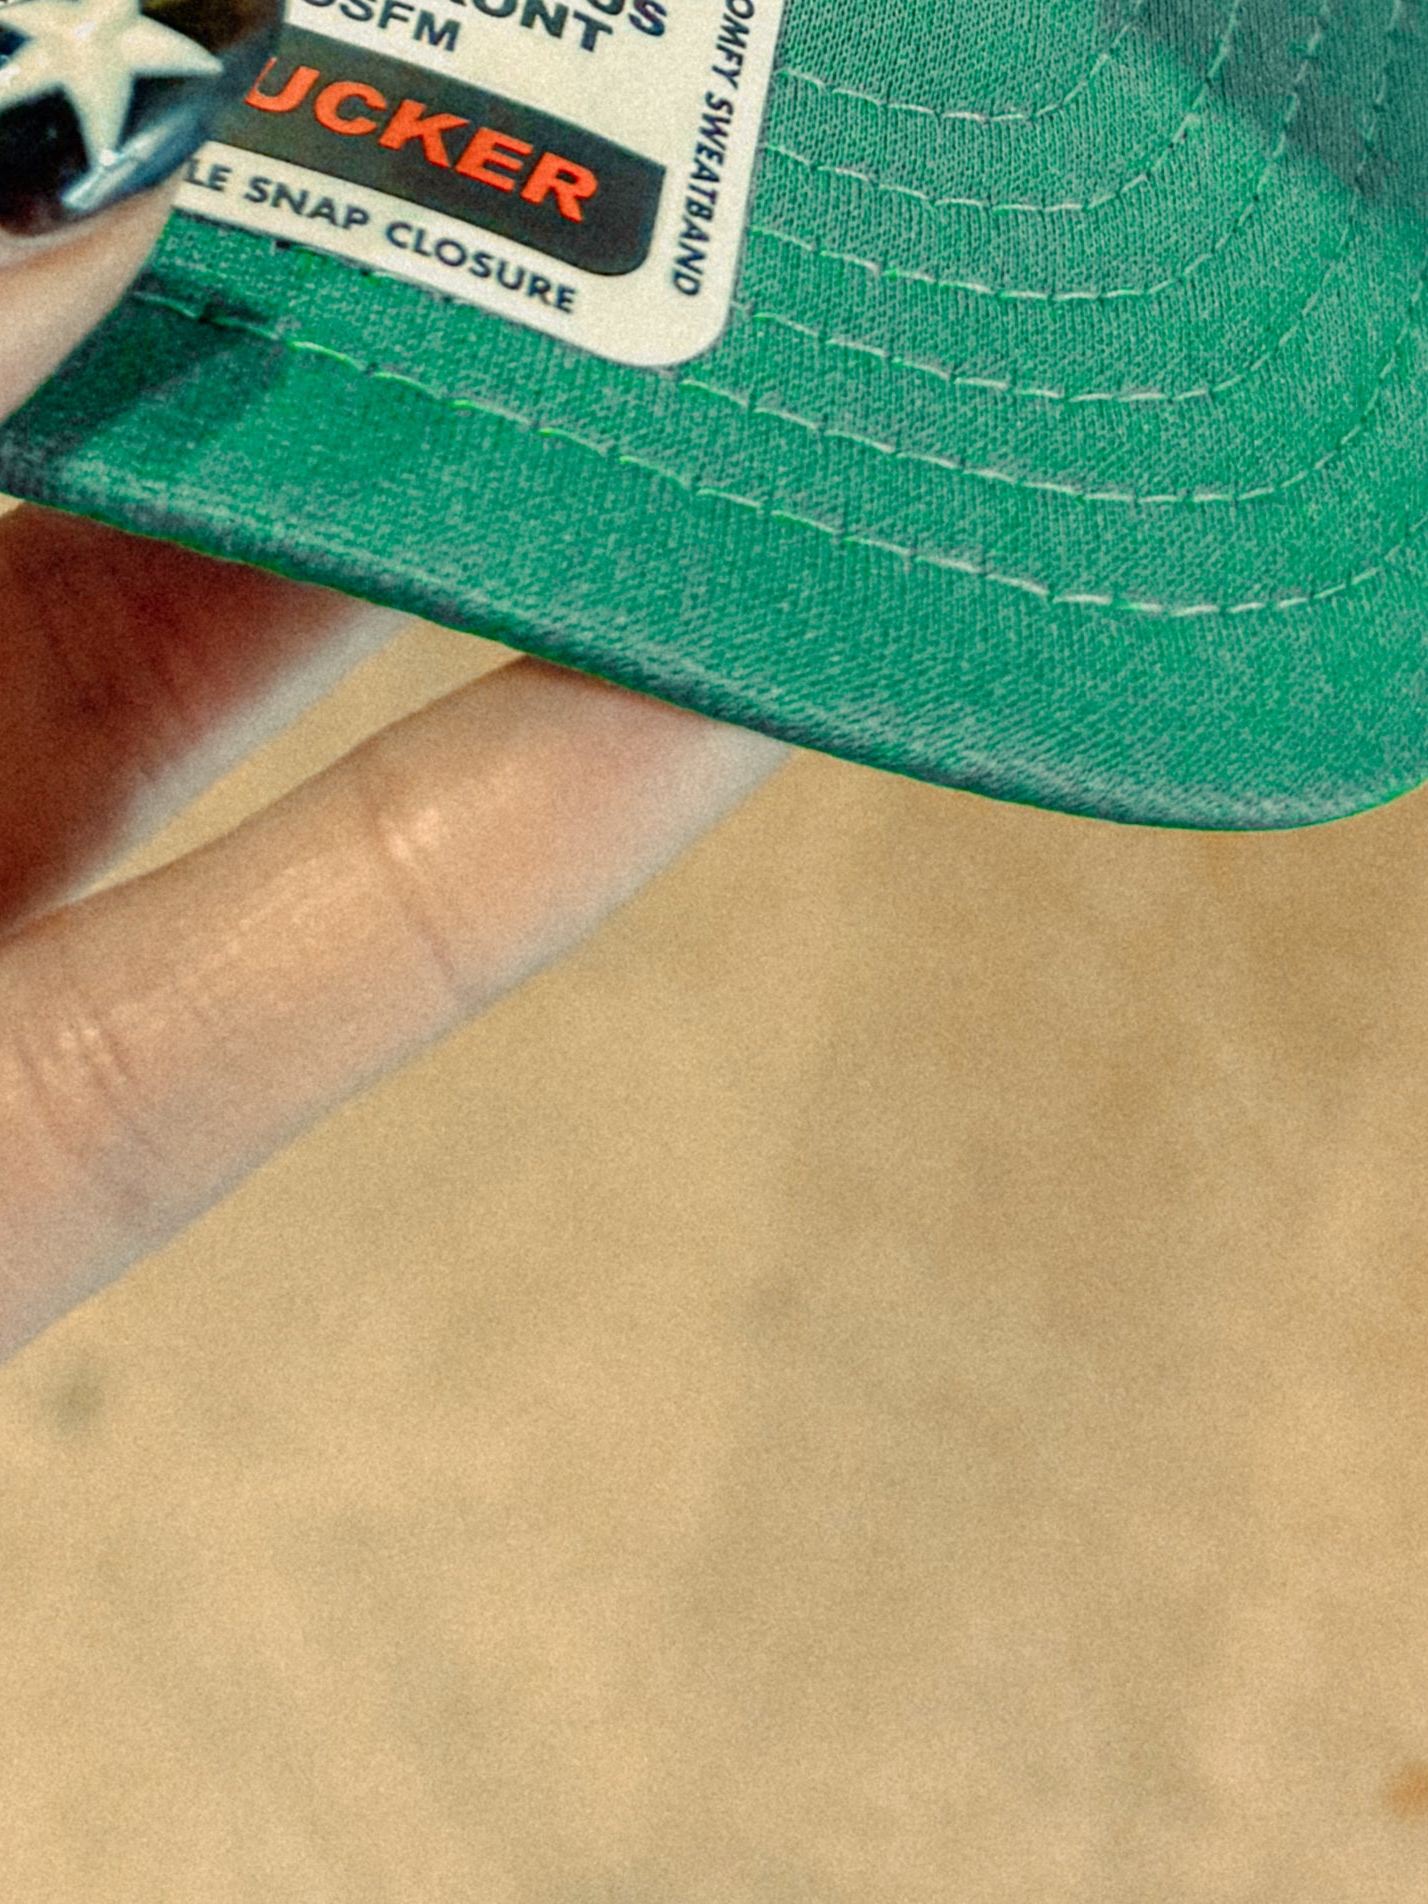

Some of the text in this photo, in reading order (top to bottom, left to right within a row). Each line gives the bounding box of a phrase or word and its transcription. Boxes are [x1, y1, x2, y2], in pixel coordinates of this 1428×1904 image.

[243, 57, 599, 224] UCKER
[672, 91, 735, 297] SWEATBAND
[243, 175, 579, 314] SNAP CLOSURE
